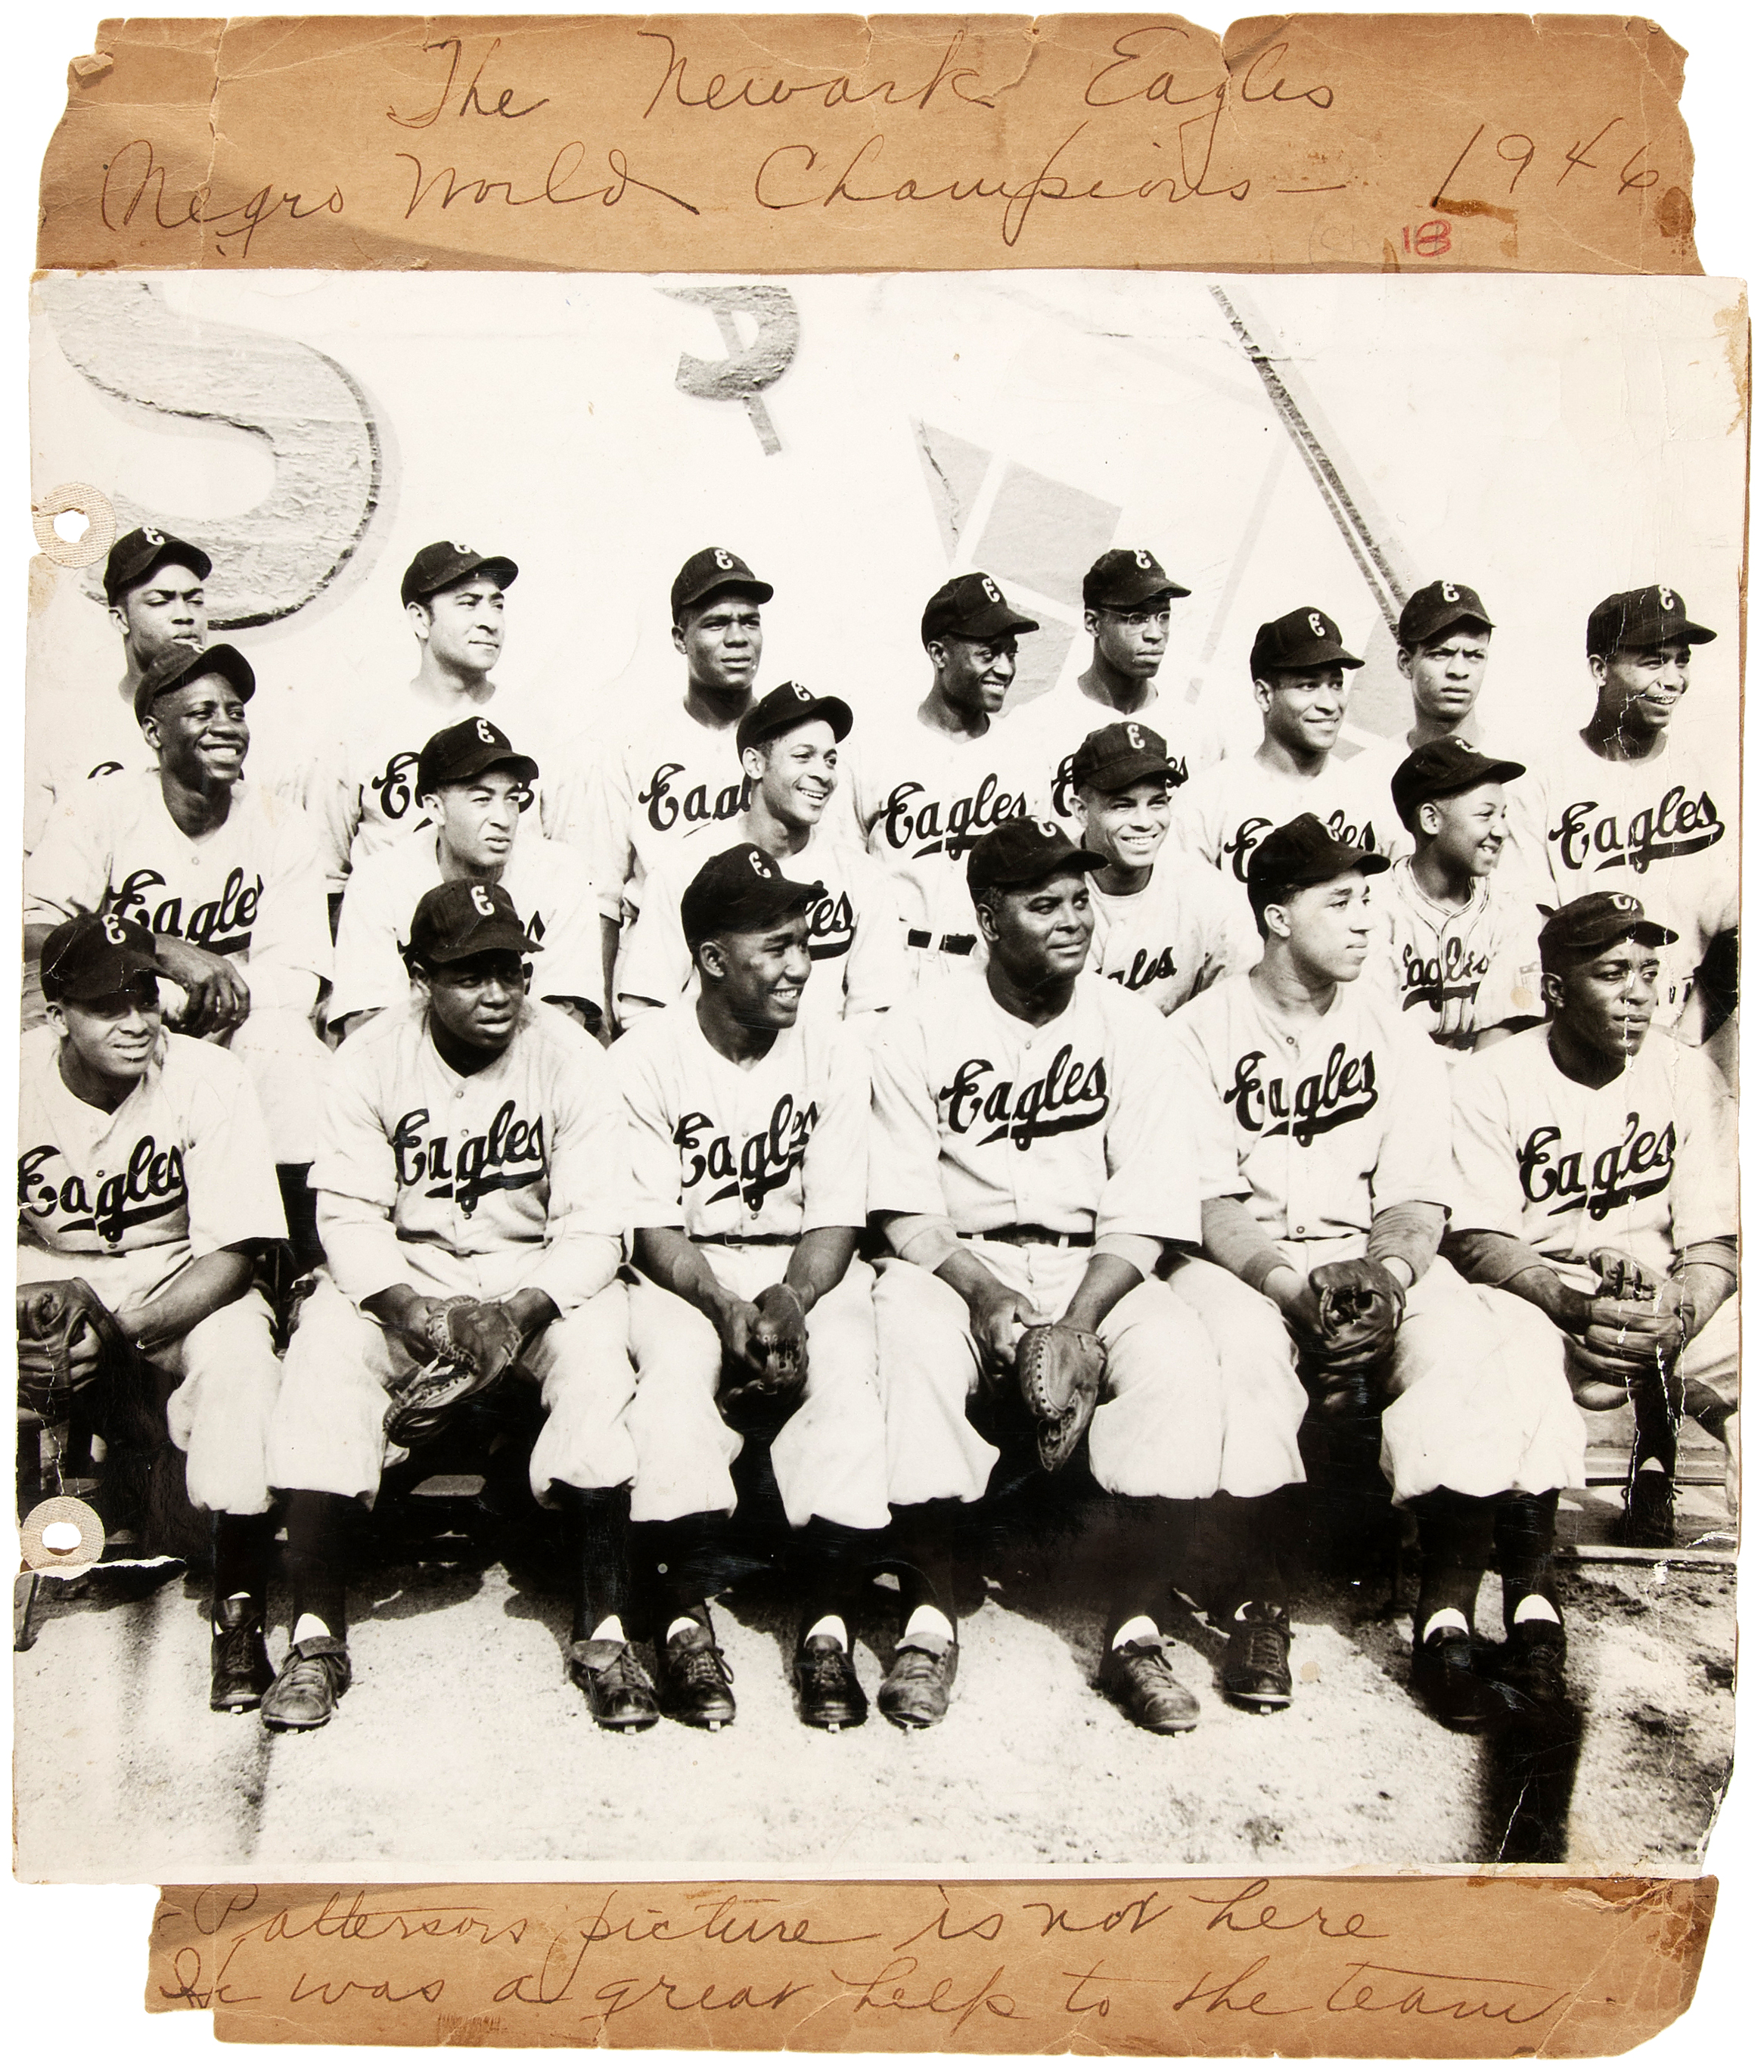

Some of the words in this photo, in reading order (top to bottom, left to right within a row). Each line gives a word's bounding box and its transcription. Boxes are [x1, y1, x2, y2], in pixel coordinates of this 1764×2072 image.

[388, 36, 550, 129] The
[638, 30, 995, 119] Newark
[1085, 26, 1334, 194] Eagles
[101, 139, 345, 257] Negro
[395, 141, 700, 215] World
[757, 123, 1250, 247] Champions
[1430, 116, 1659, 208] 1946
[1402, 219, 1452, 257] 18
[715, 548, 734, 570] E
[982, 577, 1000, 603] E
[1442, 581, 1460, 602] E
[1658, 584, 1675, 610] E
[1308, 613, 1325, 637] E
[477, 719, 495, 744] E
[1127, 724, 1146, 749] E
[880, 772, 1027, 861] Eagles
[1548, 785, 1725, 874] Eagles
[749, 850, 772, 878] E
[471, 885, 495, 916] E
[101, 913, 126, 945] E
[939, 1043, 1110, 1151] Eagles
[1225, 1042, 1378, 1147] Eagles
[392, 1100, 548, 1212] Eagles
[18, 1135, 189, 1243] Eagles
[893, 1885, 1004, 1940] is
[1023, 1891, 1172, 1937] not
[1189, 1879, 1390, 1938] here
[290, 1973, 445, 2005] was
[493, 1974, 561, 2004] a
[579, 1974, 815, 2039] great
[831, 1956, 1031, 2036] help
[1172, 1956, 1313, 2015] the
